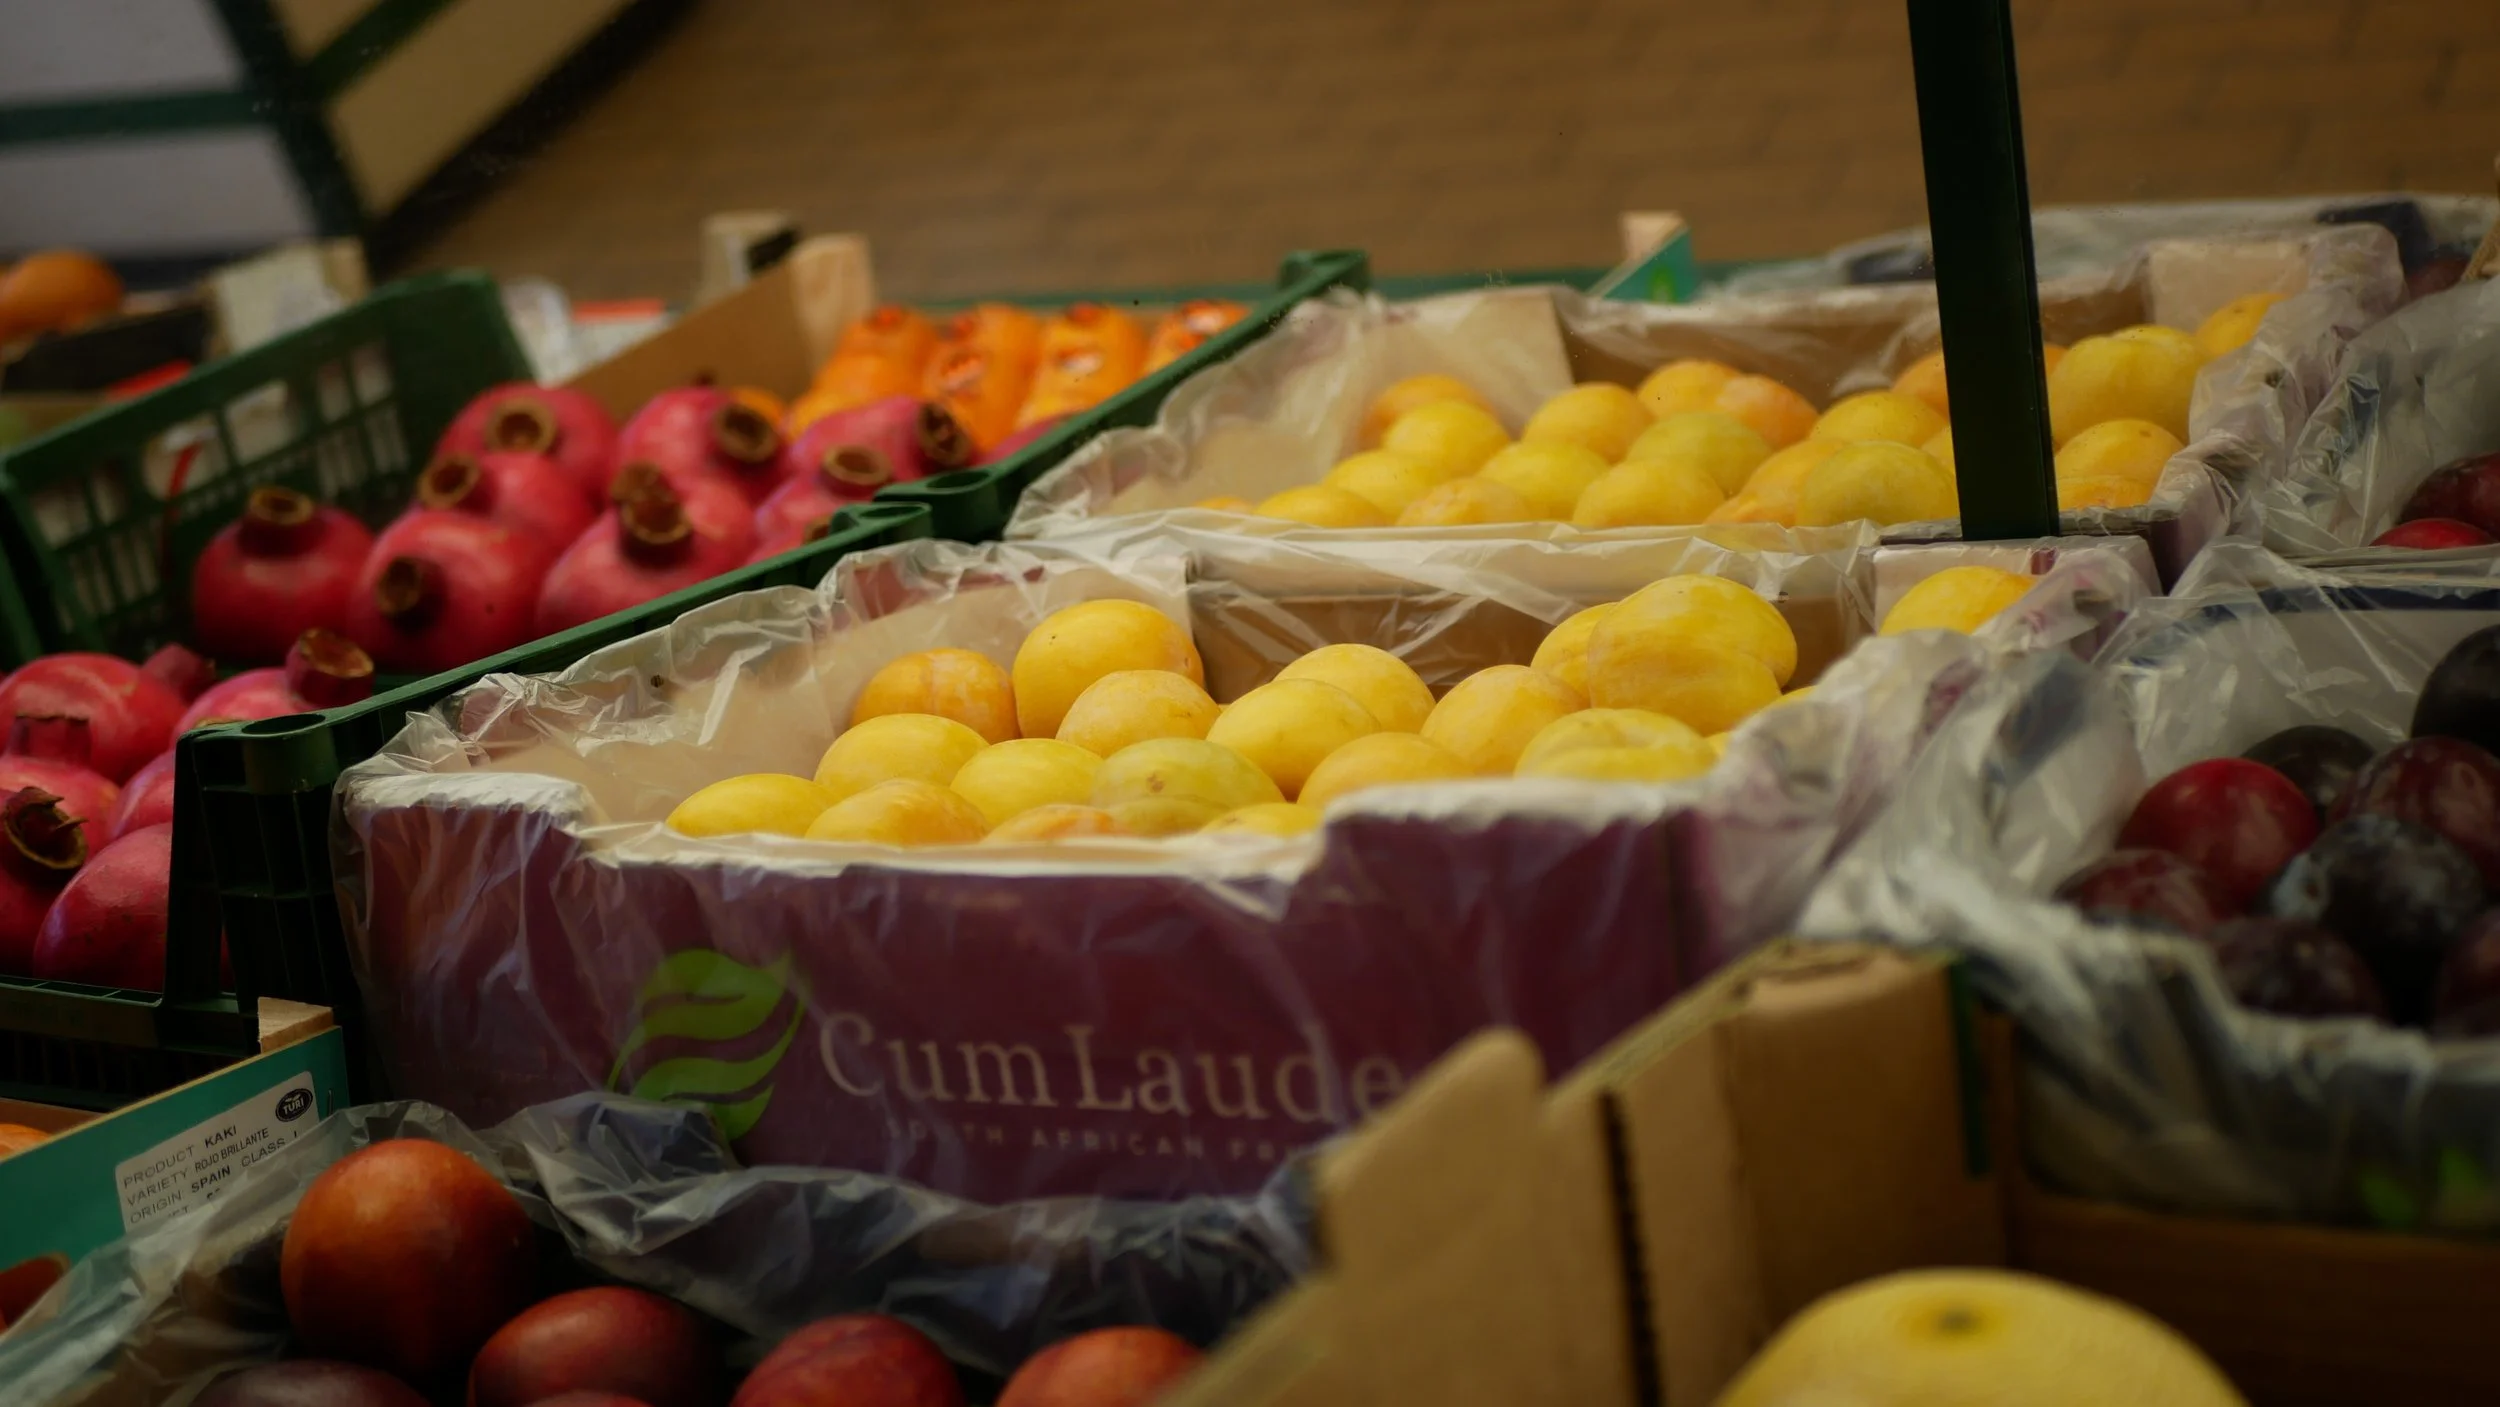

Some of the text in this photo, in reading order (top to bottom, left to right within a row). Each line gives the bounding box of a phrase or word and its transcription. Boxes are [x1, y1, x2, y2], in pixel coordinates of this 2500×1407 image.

[820, 1012, 1404, 1125] Cum Laude
[283, 1097, 304, 1115] TURI
[123, 1125, 237, 1189] PRODUCT KAKI
[127, 1127, 269, 1207] VARIETY ROJO BRILLANTE
[191, 1165, 231, 1193] SPAIN
[241, 1137, 286, 1167] CLASS
[1032, 1128, 1203, 1160] AFRICAN
